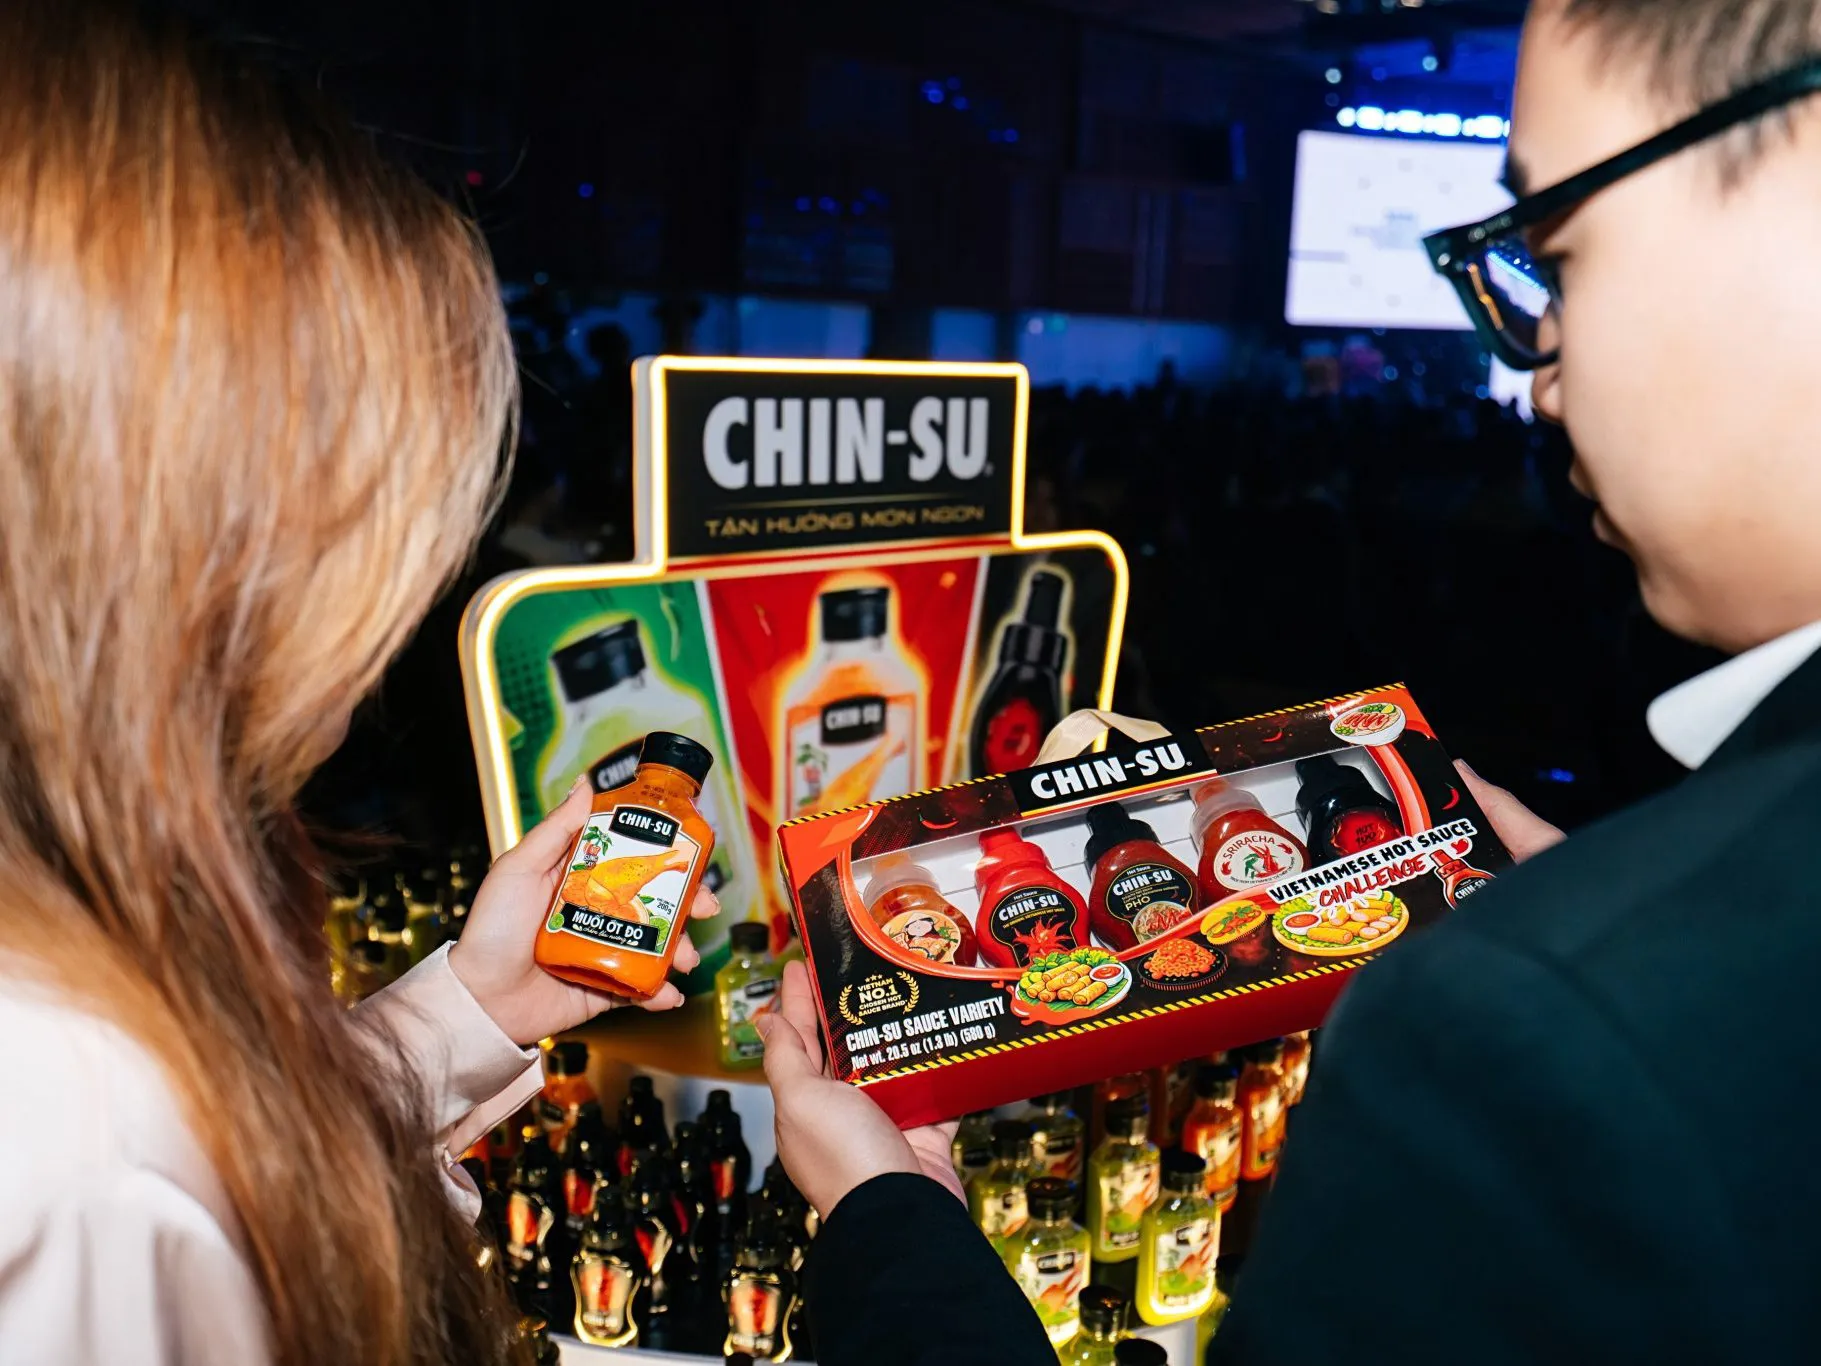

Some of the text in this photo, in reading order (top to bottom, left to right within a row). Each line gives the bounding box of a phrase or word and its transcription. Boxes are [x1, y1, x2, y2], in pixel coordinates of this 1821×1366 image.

[703, 396, 989, 490] CHIN-SU
[1030, 743, 1186, 799] CHIN-SU
[618, 811, 673, 837] CHIN-SU
[1222, 835, 1276, 859] SRIRACHA
[1269, 852, 1383, 901] VIETNAMESE
[1382, 839, 1416, 862] HOT
[1417, 820, 1474, 848] SAUCE
[1113, 869, 1173, 896] CHIN-SU
[1318, 853, 1428, 907] CHALLENGE
[998, 894, 1059, 921] CHIN-SU
[1125, 895, 1151, 911] PHO
[858, 977, 894, 991] VIETNAM
[859, 984, 899, 1003] NO.1
[858, 1006, 882, 1017] SAUCE
[859, 994, 902, 1010] CHOSEN HOT
[845, 996, 1006, 1052] CHIN-SU SAUCE VARIETY
[851, 1022, 997, 1071] Net wt. 20.5 oz (1.3 lb) (580 g)
